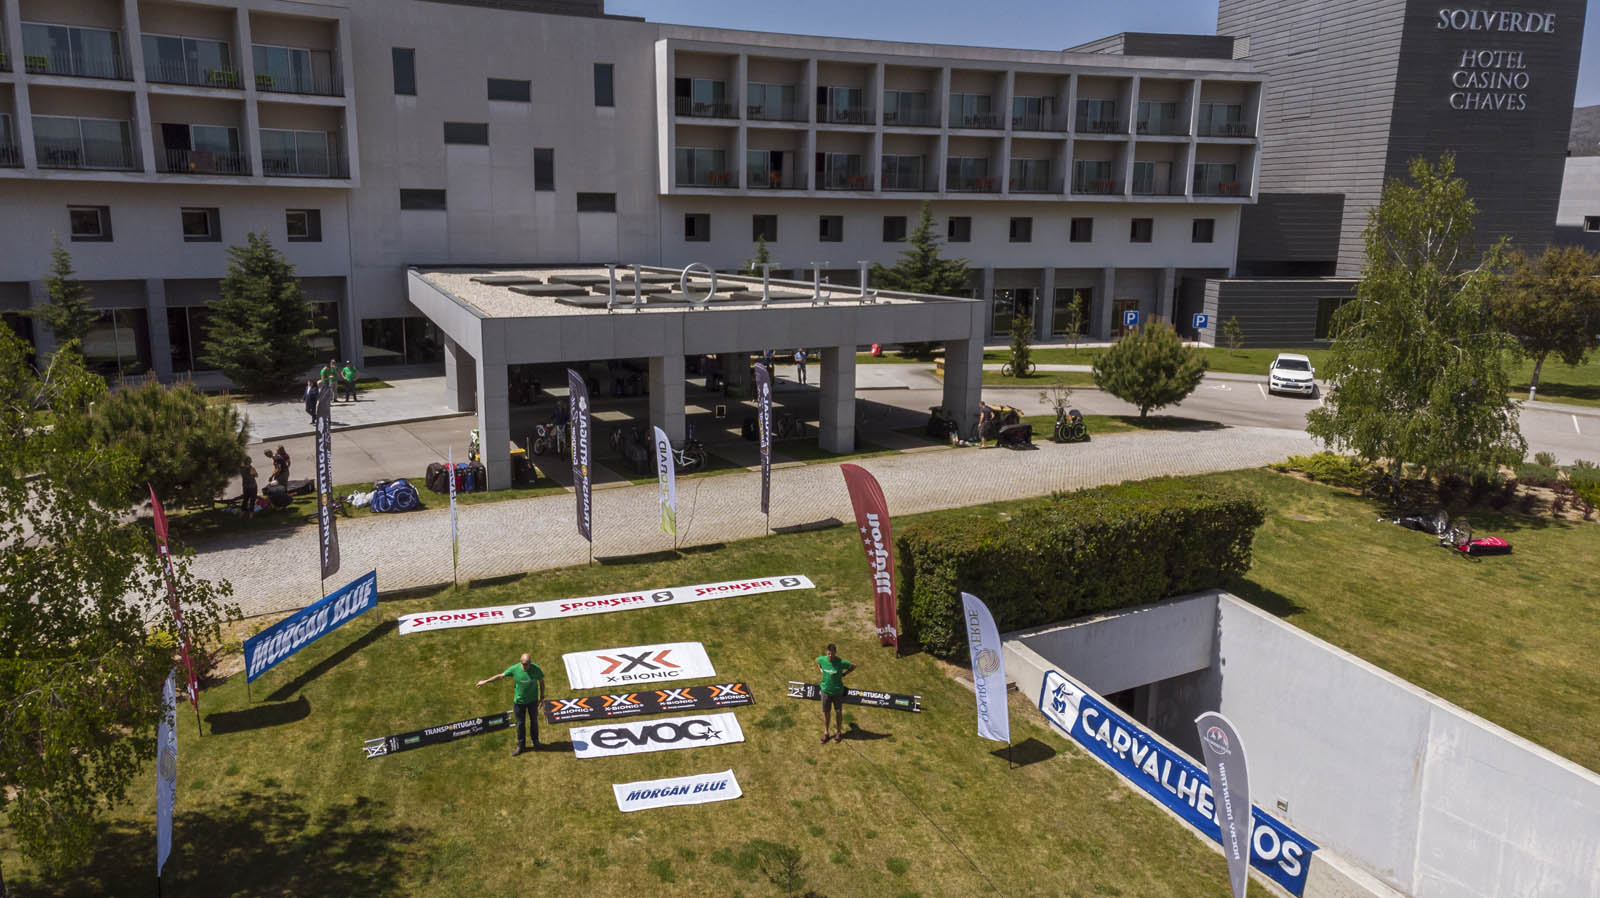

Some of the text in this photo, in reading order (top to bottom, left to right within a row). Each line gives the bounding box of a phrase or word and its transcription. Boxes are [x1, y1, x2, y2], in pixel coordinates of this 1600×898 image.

[1437, 9, 1556, 34] SOLVERDE
[1460, 49, 1526, 69] HOTEL
[1452, 71, 1530, 89] CASINO
[1450, 92, 1527, 110] CHAVES
[1127, 312, 1136, 324] P
[1196, 315, 1206, 327] P
[412, 611, 504, 627] SPONSER
[560, 595, 645, 612] SPONSER
[695, 581, 773, 597] SPONSER
[248, 577, 375, 677] MORGAN BLUE
[606, 670, 680, 682] X-BIONIC
[591, 720, 711, 749] evoc
[625, 779, 728, 801] MORGAN BLUE
[1081, 707, 1303, 877] CARVALHEOS
